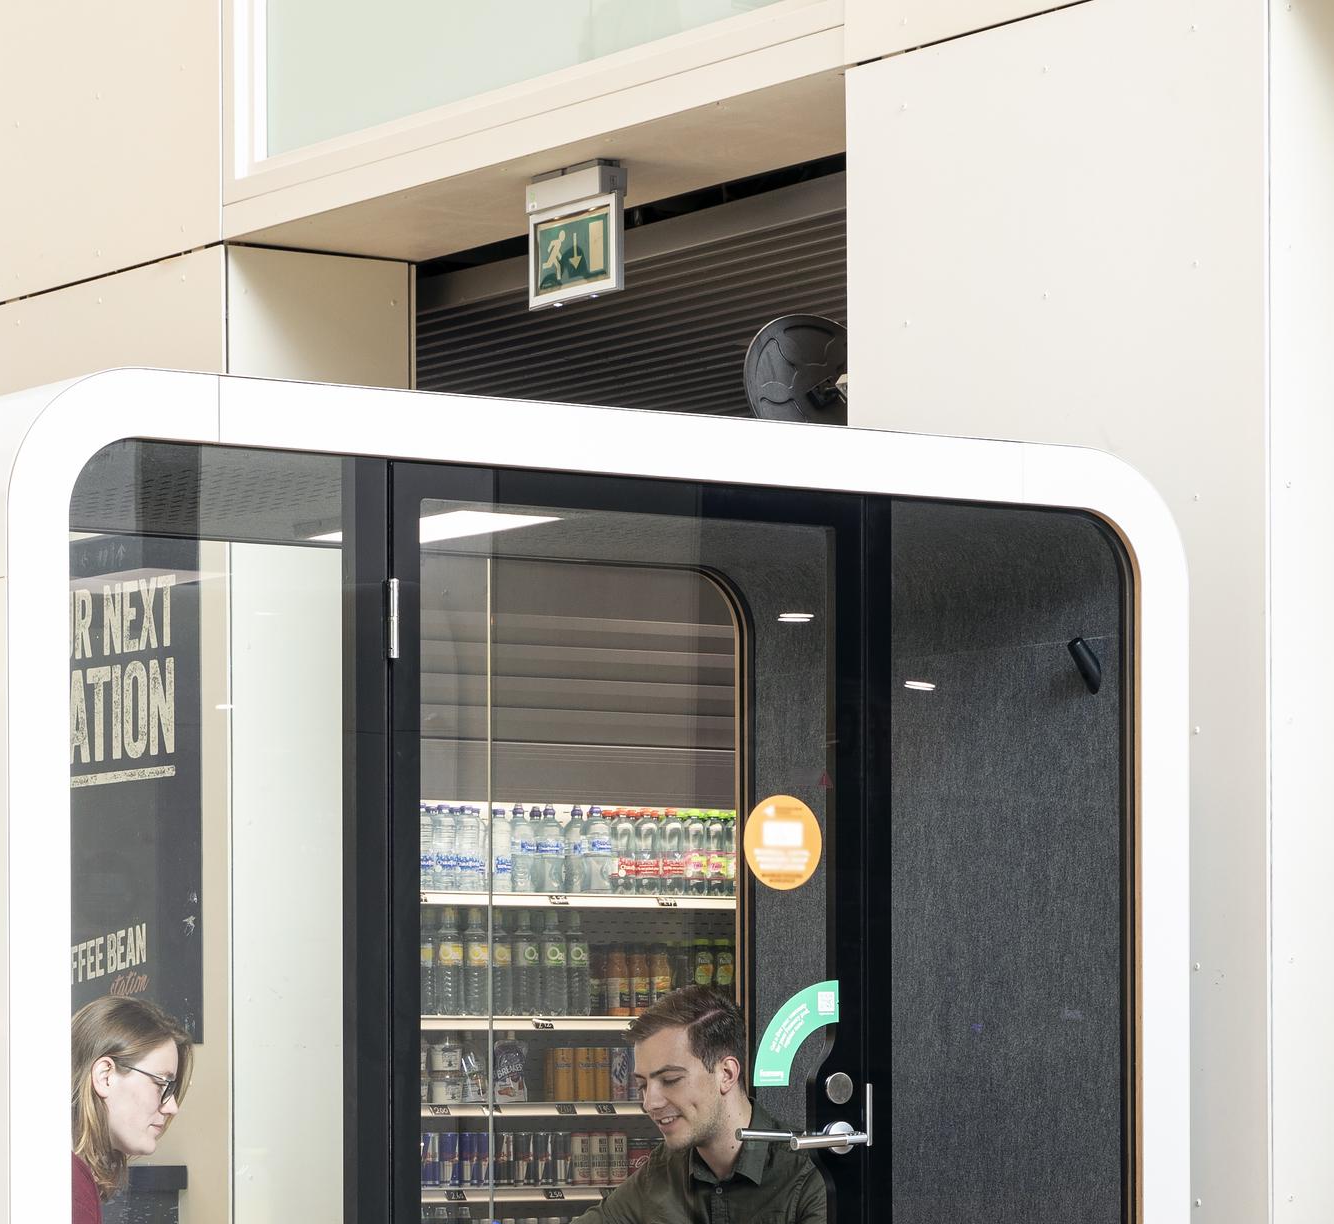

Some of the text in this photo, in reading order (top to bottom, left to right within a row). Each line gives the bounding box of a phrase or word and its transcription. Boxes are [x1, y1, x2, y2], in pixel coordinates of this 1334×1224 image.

[70, 574, 176, 660] R NEXT
[107, 922, 146, 974] BEAN
